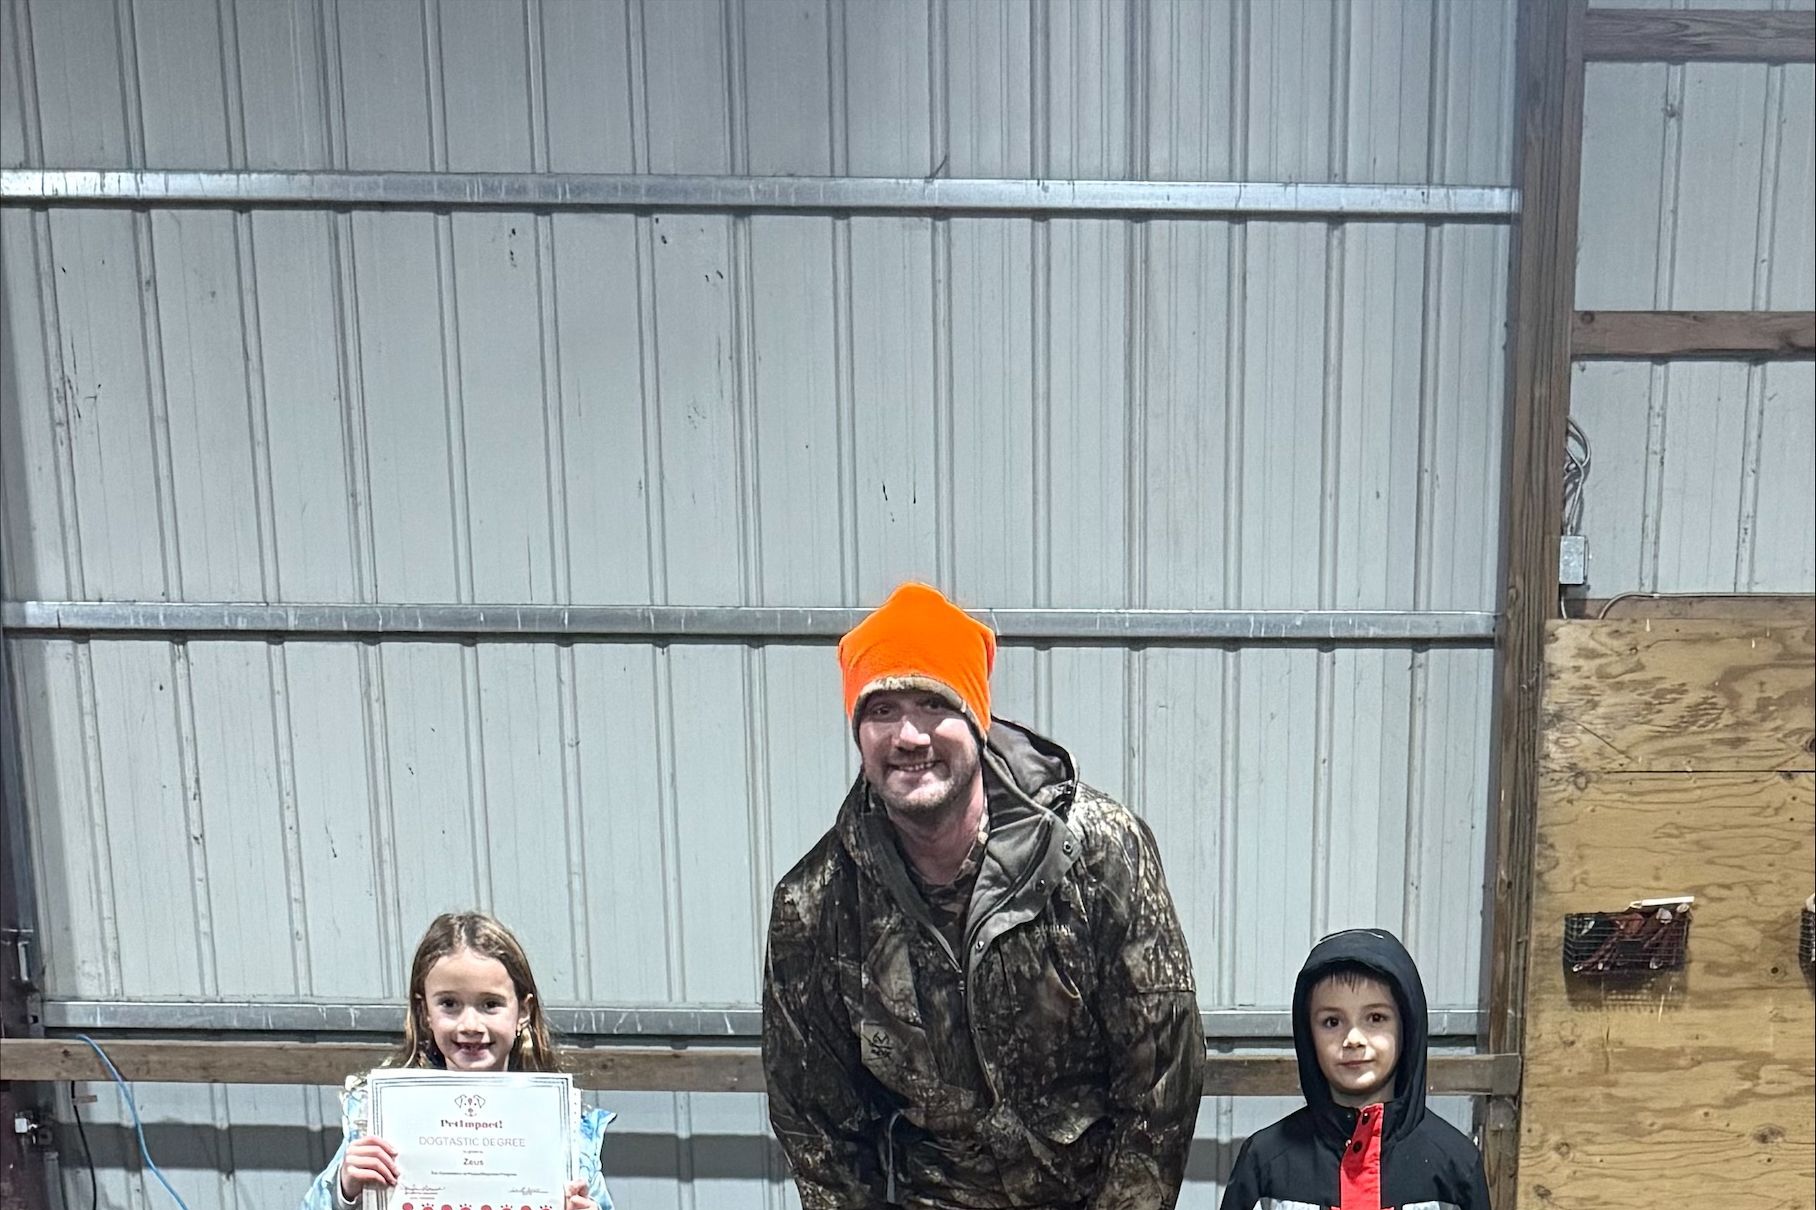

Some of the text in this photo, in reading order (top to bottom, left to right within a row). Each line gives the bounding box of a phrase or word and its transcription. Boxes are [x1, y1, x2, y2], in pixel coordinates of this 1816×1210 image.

[440, 1119, 503, 1130] PetImpact!
[419, 1136, 526, 1147] DOGTASTIC DEGREE
[463, 1158, 484, 1166] Zeus
